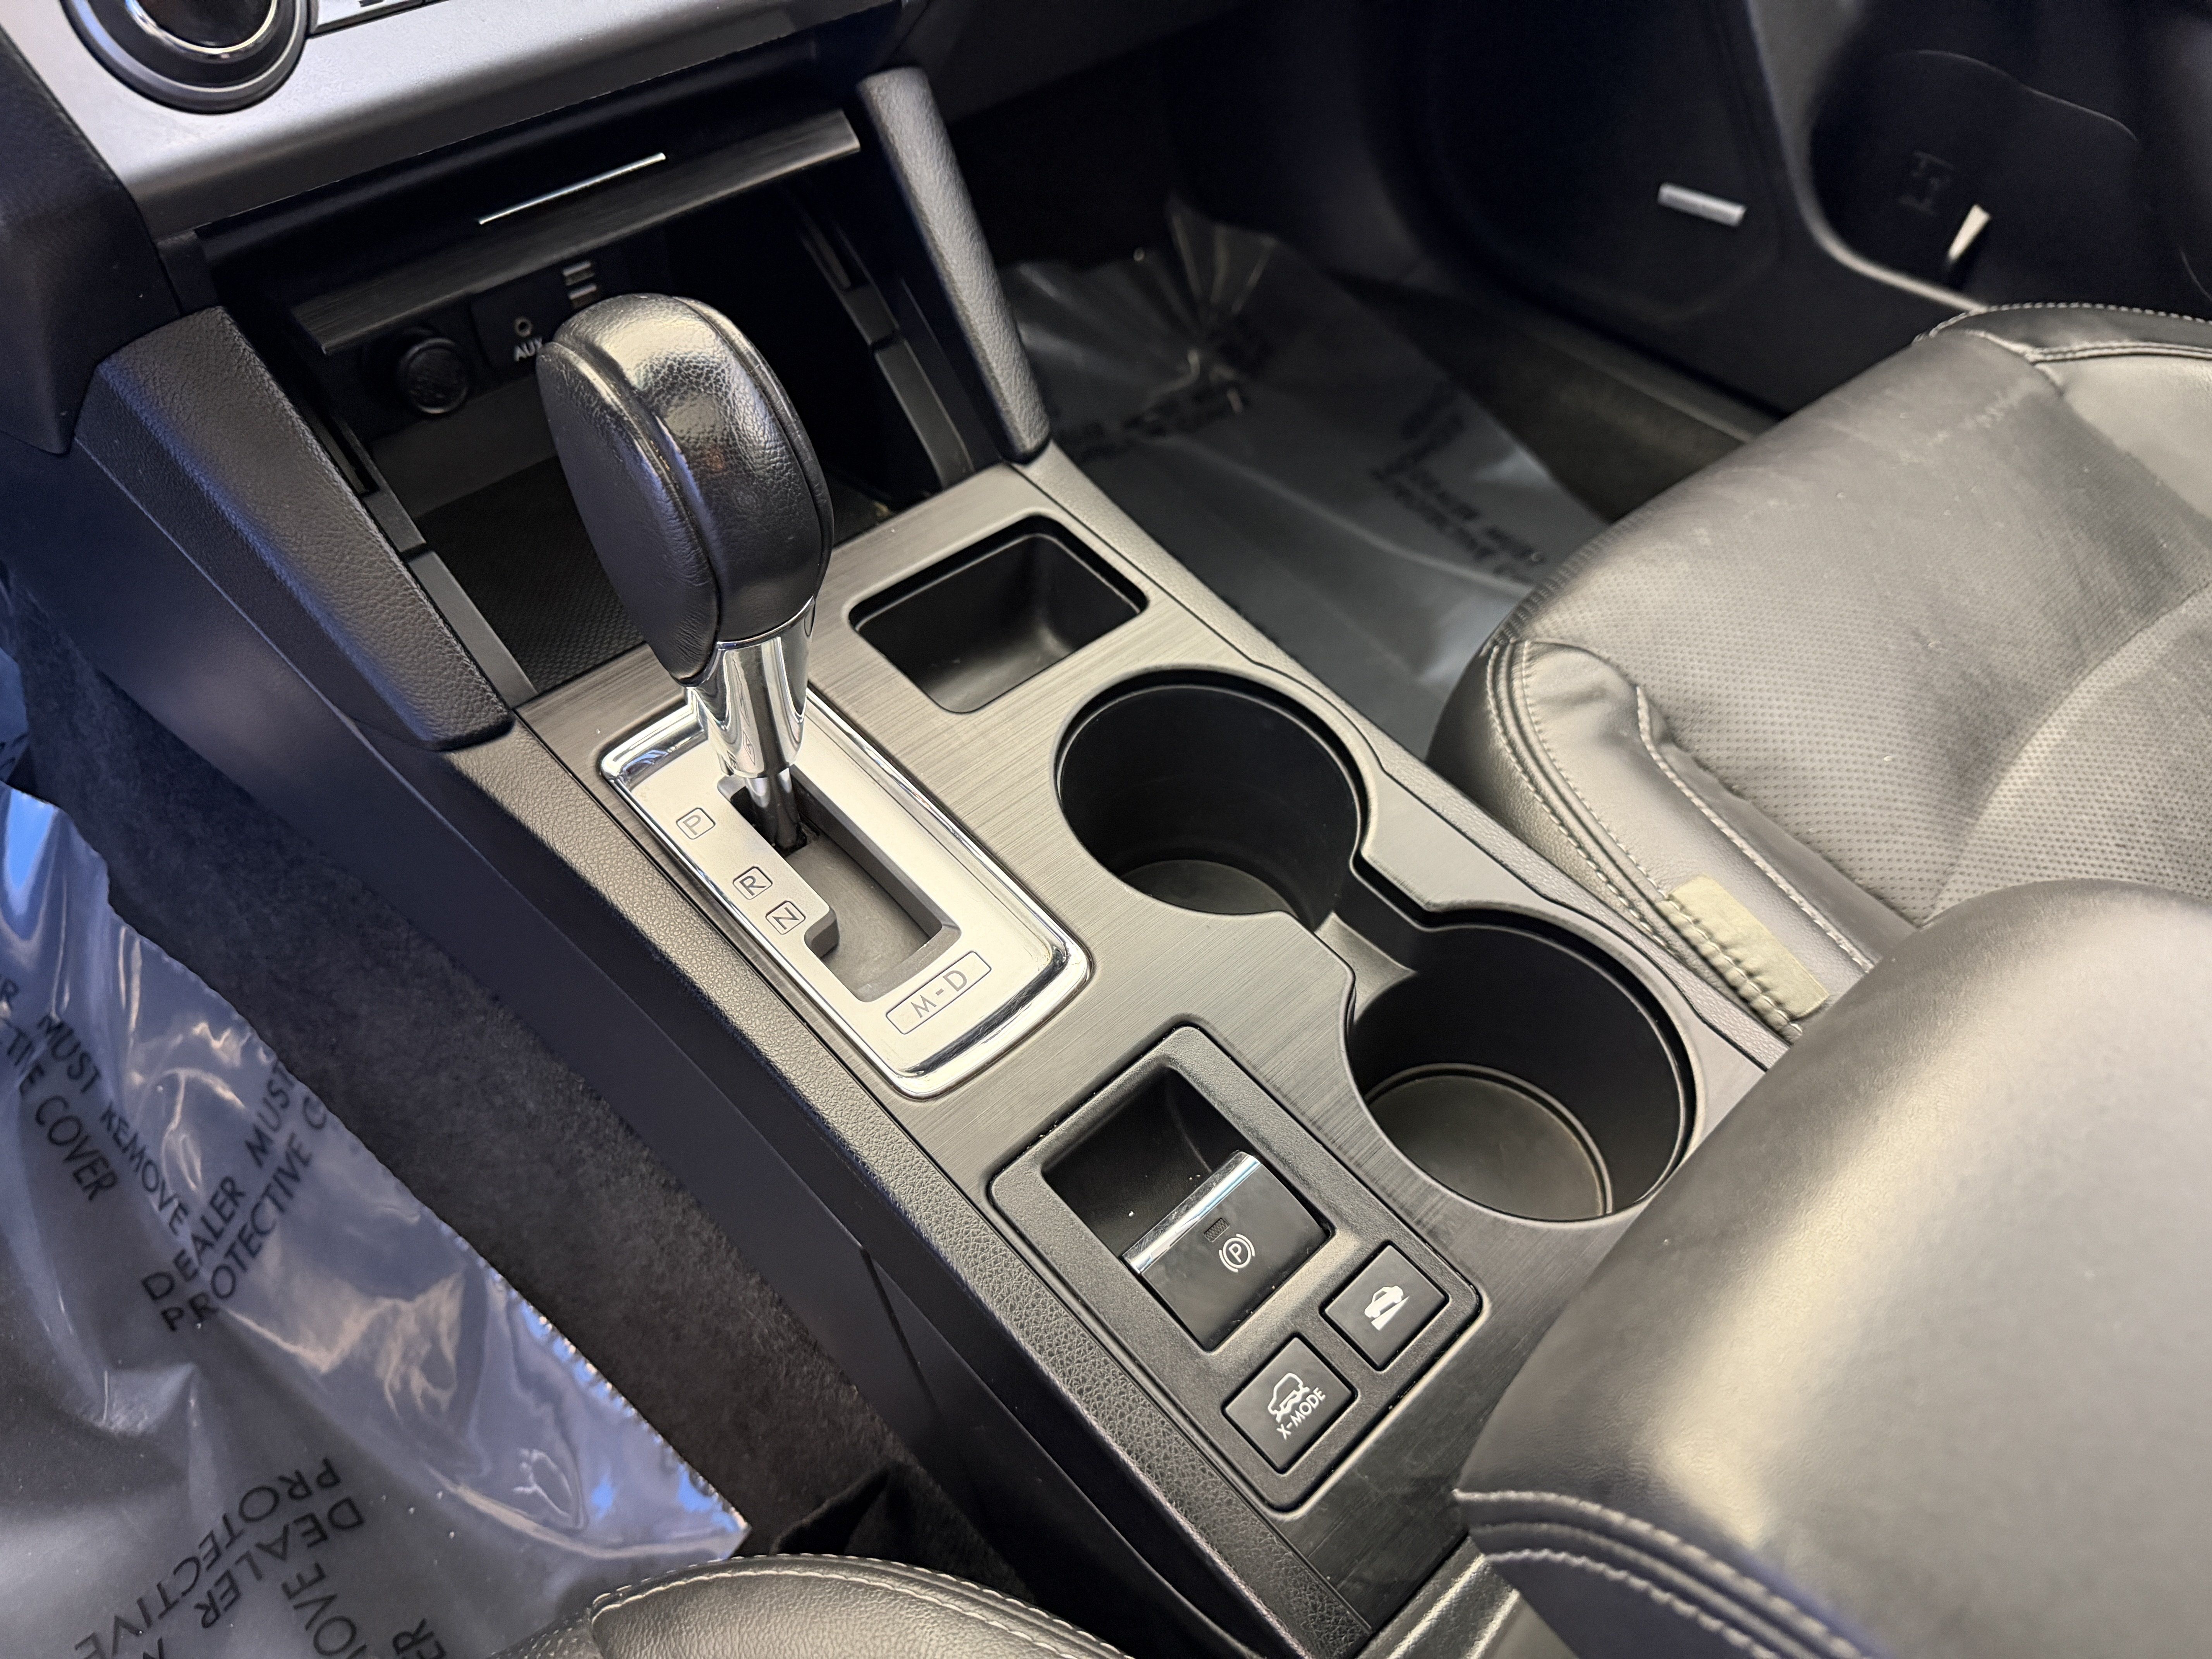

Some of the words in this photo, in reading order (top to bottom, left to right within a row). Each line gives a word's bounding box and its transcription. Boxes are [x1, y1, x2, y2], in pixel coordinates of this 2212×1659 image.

[682, 815, 701, 835] P
[739, 876, 767, 896] R
[772, 907, 800, 930] N
[35, 1095, 118, 1202] COVER
[37, 1013, 101, 1094] MUST
[100, 1100, 189, 1237] REMOVE
[141, 1176, 245, 1300] DEALER
[245, 1059, 294, 1168] MUST
[160, 1132, 312, 1332] PROTECTIVE
[1276, 1387, 1326, 1440] X-MODE
[74, 1458, 342, 1659] PROTECTIVE
[194, 1496, 366, 1628] DEALER
